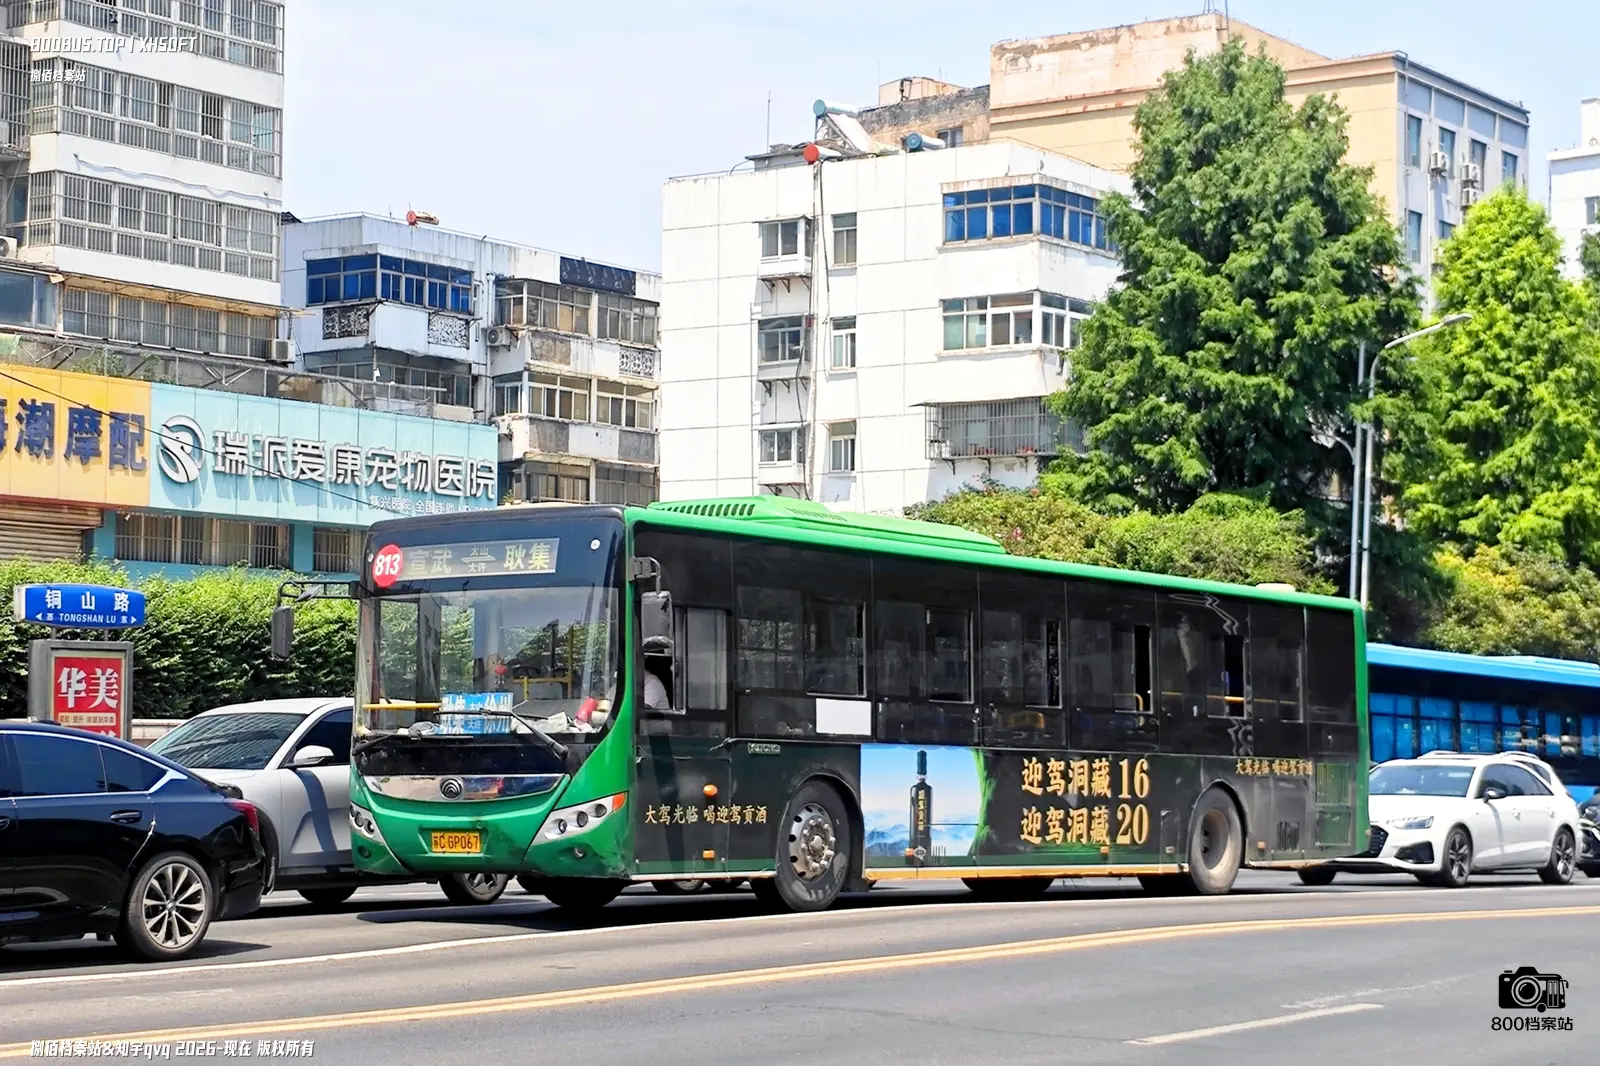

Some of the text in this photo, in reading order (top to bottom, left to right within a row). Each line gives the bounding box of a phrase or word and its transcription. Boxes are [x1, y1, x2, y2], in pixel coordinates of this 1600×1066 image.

[0, 398, 147, 471] 潮摩配
[213, 431, 496, 499] 瑞派爱康宠物医院
[375, 553, 400, 576] 813
[503, 542, 551, 571] 耿集
[45, 589, 130, 612] 铜山路
[46, 613, 54, 621] 西
[59, 613, 104, 623] TONGSHAN
[106, 615, 116, 623] LU
[57, 667, 119, 709] 华美
[1021, 756, 1150, 798] 迎驾洞藏 16
[644, 804, 768, 825] 大驾光临 喝迎驾贡酒
[1020, 803, 1149, 845] 迎驾洞藏 20
